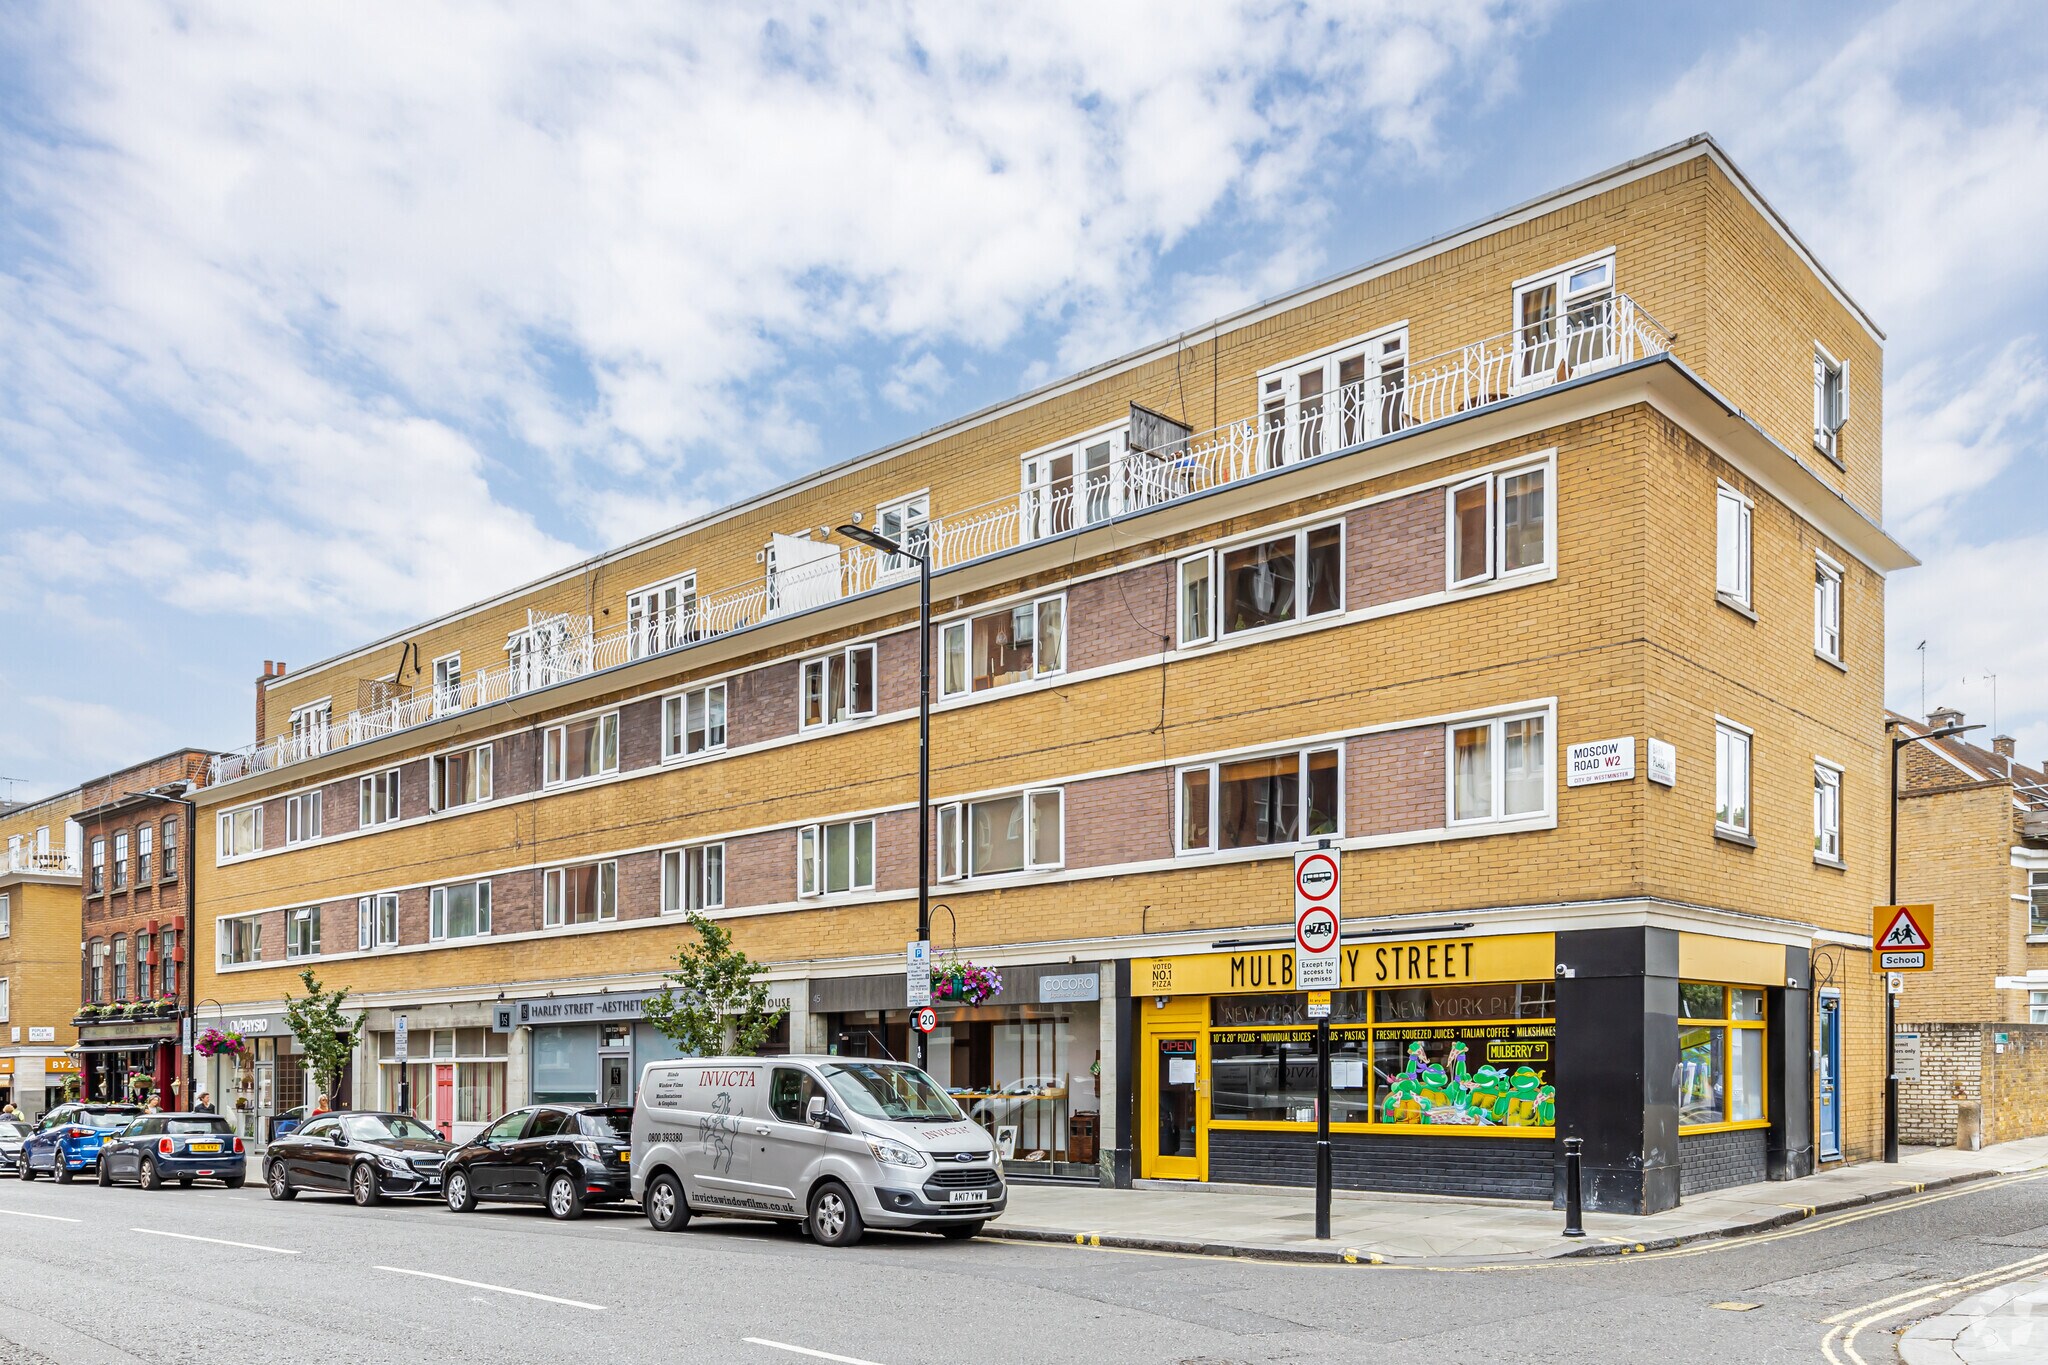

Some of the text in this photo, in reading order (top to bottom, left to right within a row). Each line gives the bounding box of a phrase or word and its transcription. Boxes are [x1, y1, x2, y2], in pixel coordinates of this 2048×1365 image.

[1573, 743, 1619, 759] MOSCOW
[1574, 755, 1621, 772] ROAD W2
[1594, 771, 1629, 781] WESTMINSTER
[1313, 922, 1331, 934] 7.5T
[1230, 942, 1474, 988] MULBY STREET
[1301, 961, 1323, 969] Except
[1886, 956, 1920, 964] School
[1152, 963, 1172, 971] VOTED
[1152, 970, 1172, 981] NO.1
[1043, 977, 1094, 991] COCORO
[1152, 980, 1172, 988] PIZZA
[812, 994, 821, 1003] 45
[531, 1004, 562, 1017] HARLEY
[563, 1002, 594, 1015] STREET
[1388, 998, 1426, 1019] NEW
[1434, 996, 1484, 1016] YORK
[921, 1014, 935, 1026] 20
[1221, 1033, 1226, 1042] &
[1237, 1033, 1256, 1043] PIZZAS
[1260, 1032, 1291, 1042] INDIVIDUAL
[1292, 1031, 1311, 1042] SLICES
[1344, 1030, 1366, 1041] PASTAS
[1376, 1026, 1556, 1040] FRESHLY SQUEEZED JUICES ITALIAN COFFEE MILKSHAKES
[1160, 1041, 1193, 1051] OPEN
[1490, 1044, 1545, 1058] MULBERRY ST
[699, 1070, 756, 1087] INVICTA
[648, 1132, 683, 1143] 0800 393380
[921, 1126, 970, 1140] INVICTA
[691, 1191, 795, 1213] invictawindowfilms.co.uk
[954, 1191, 984, 1202] AK17 YWW
